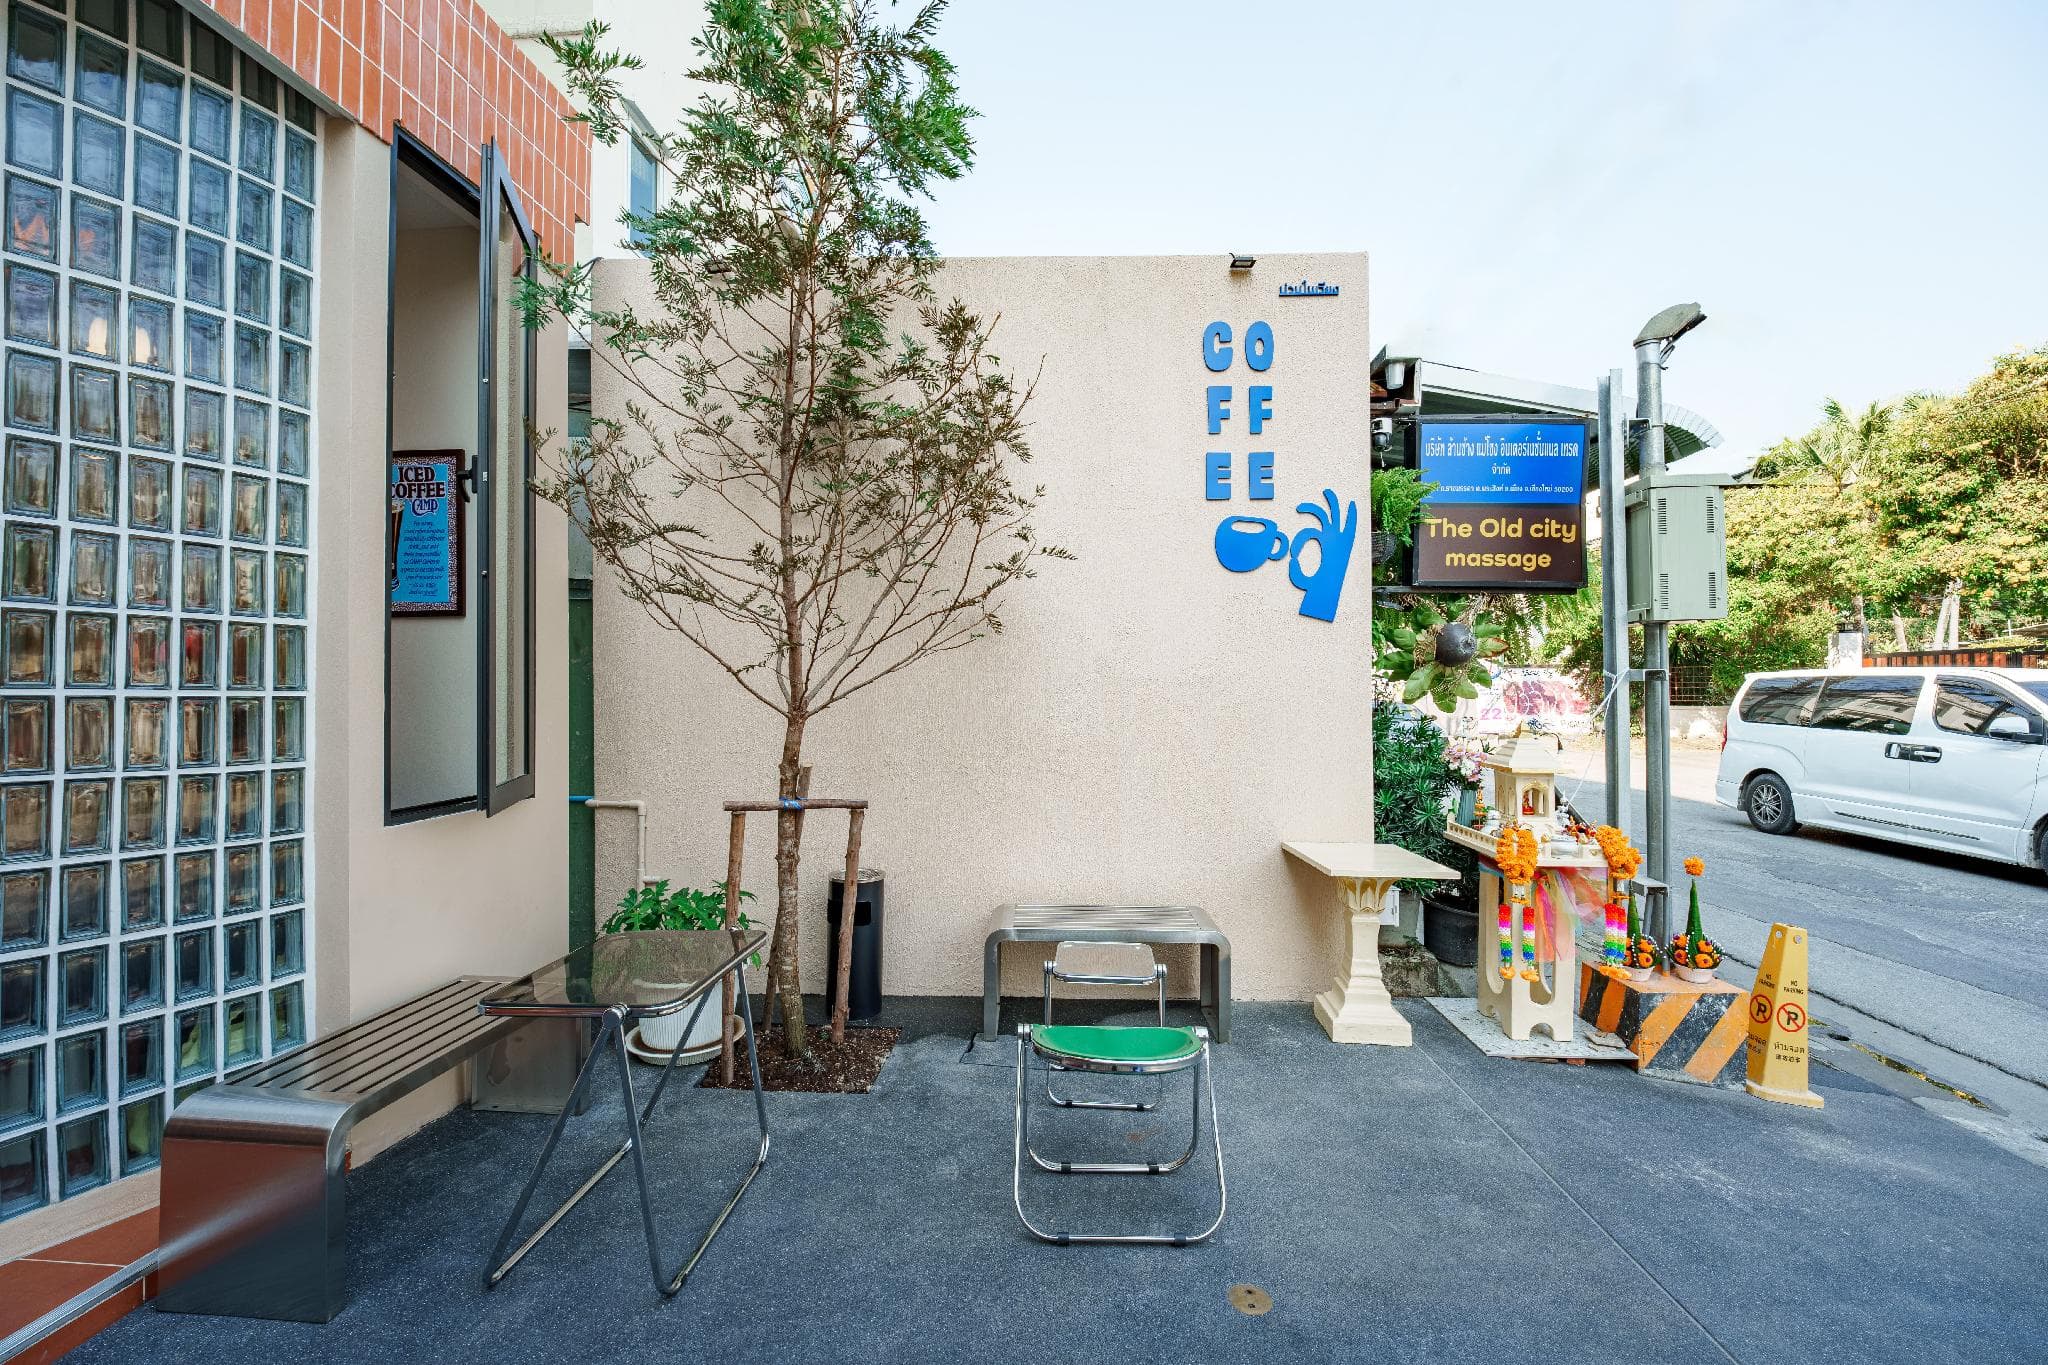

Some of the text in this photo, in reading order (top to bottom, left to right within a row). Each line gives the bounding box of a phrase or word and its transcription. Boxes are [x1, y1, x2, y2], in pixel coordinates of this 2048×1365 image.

[1425, 437, 1445, 457] บริษัท
[398, 466, 435, 482] ICED
[1491, 462, 1511, 475] จำกัด
[1425, 517, 1577, 543] The Old city
[1445, 552, 1552, 572] massage
